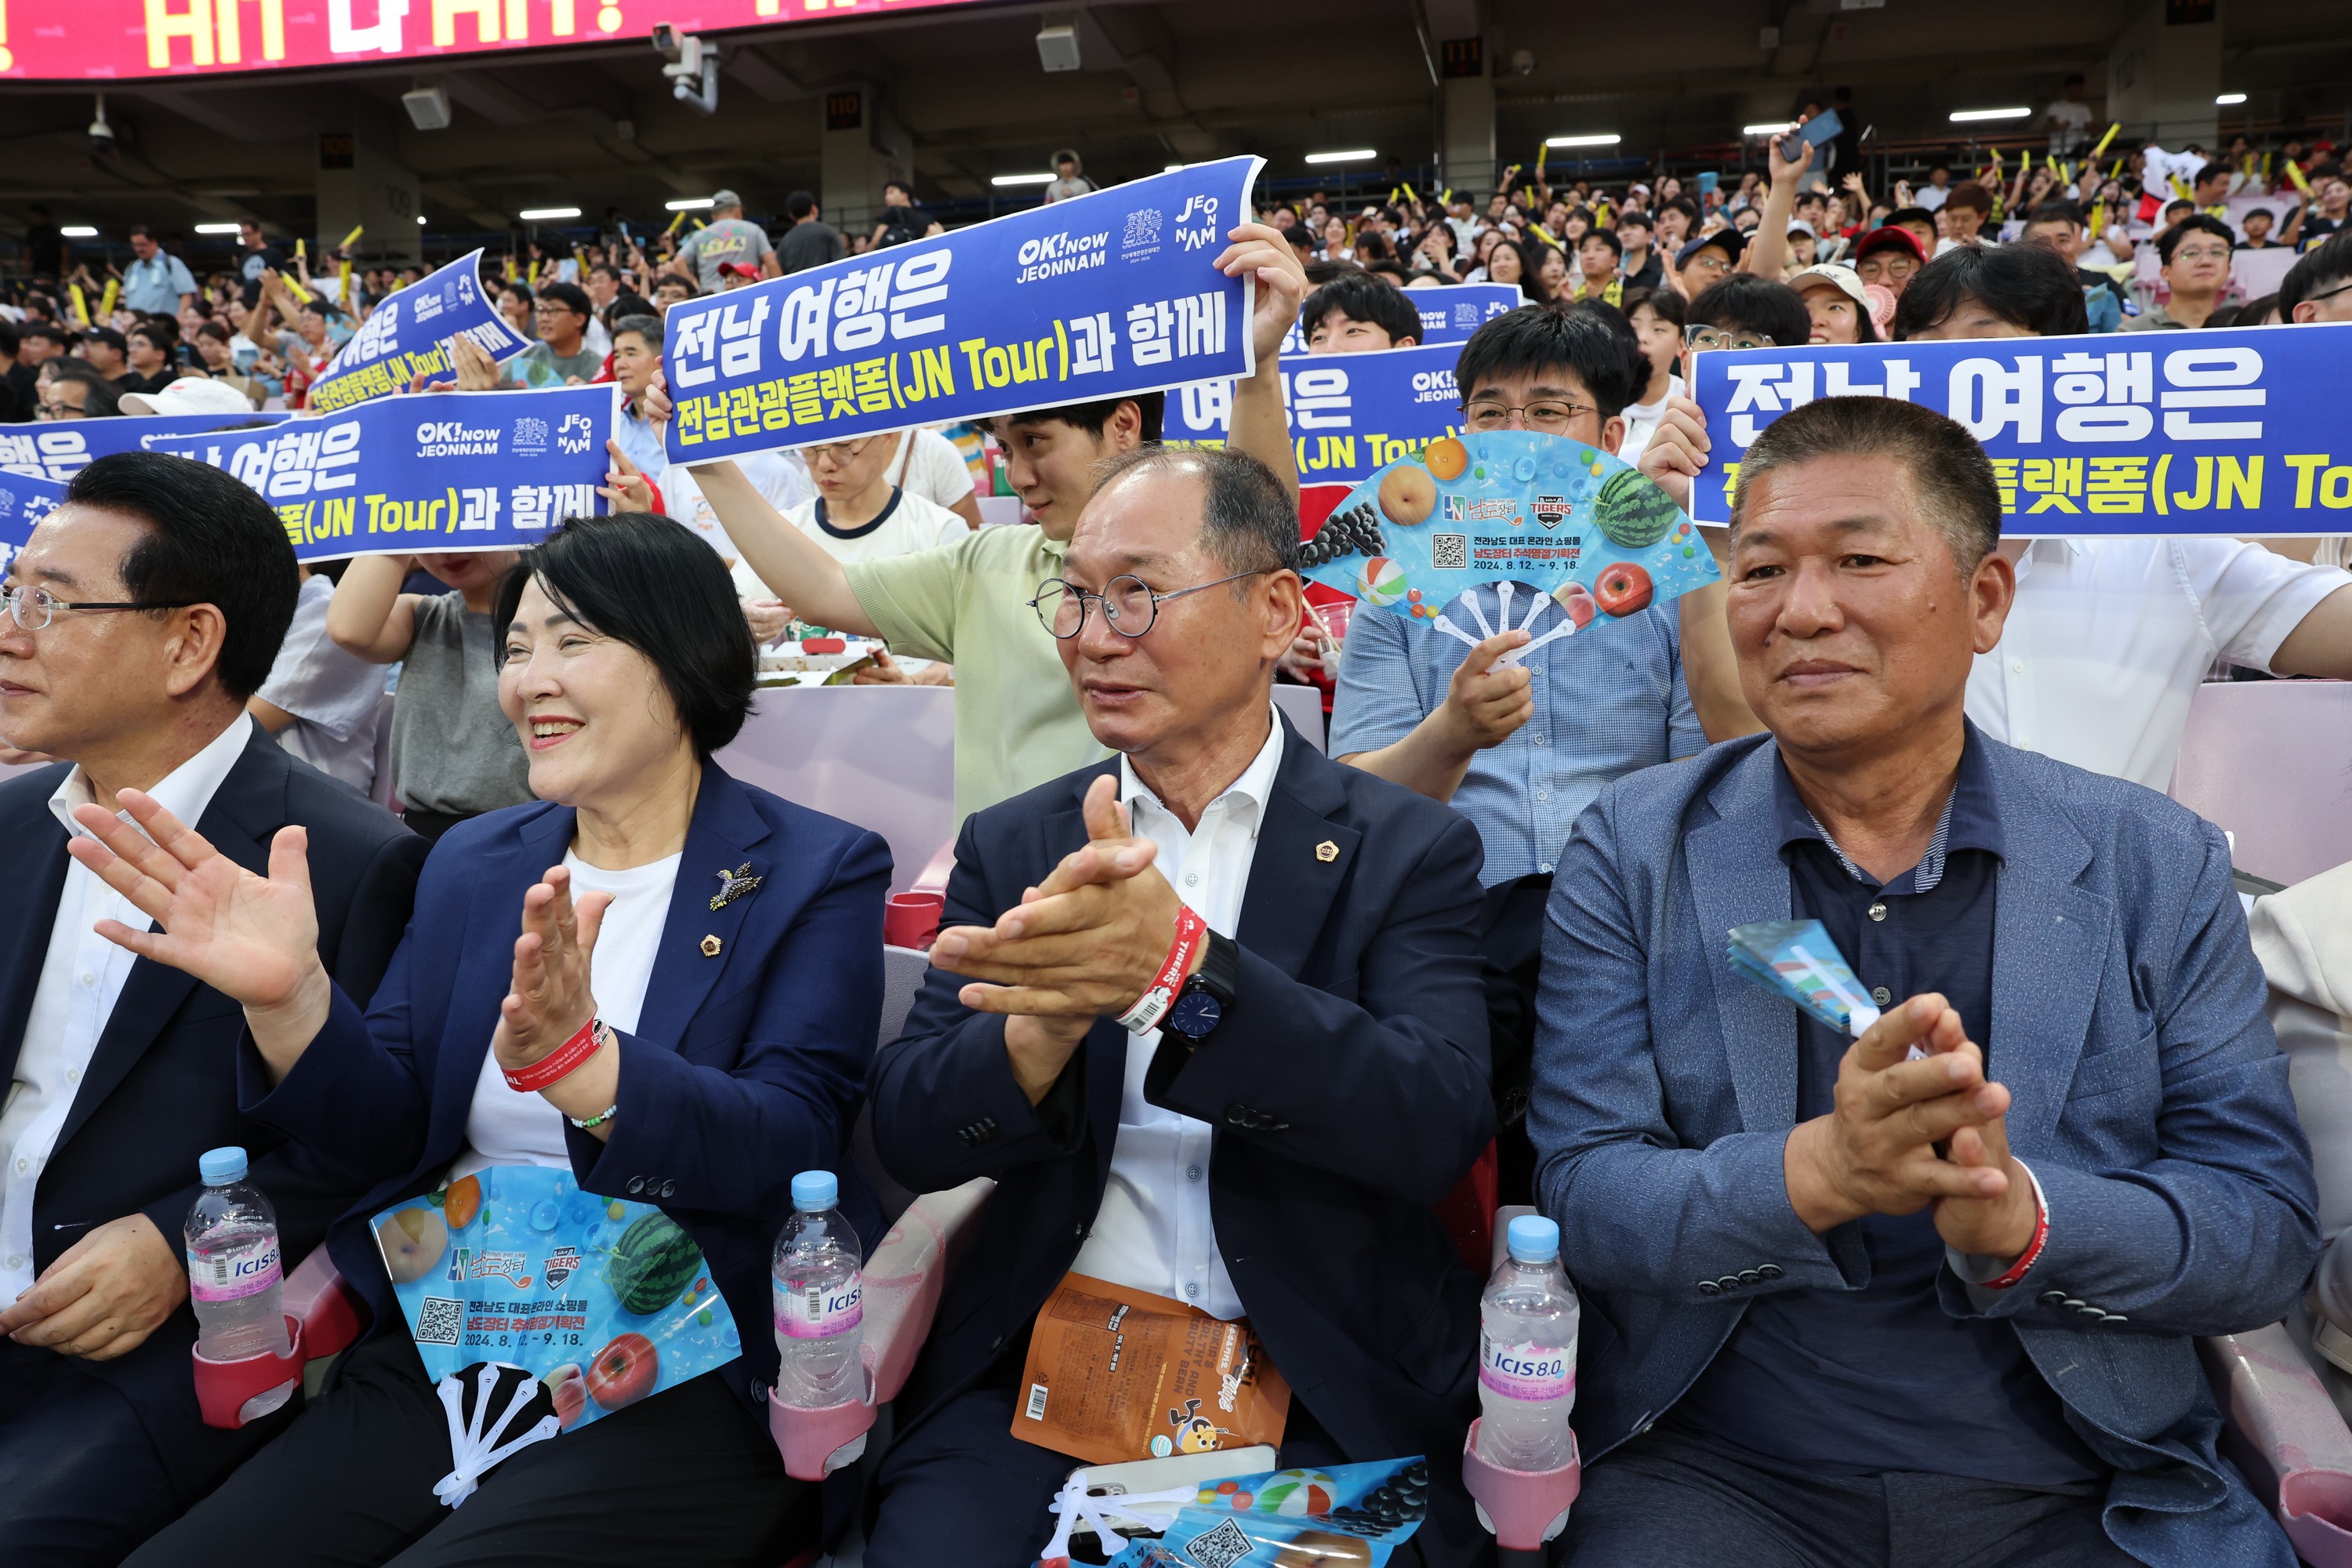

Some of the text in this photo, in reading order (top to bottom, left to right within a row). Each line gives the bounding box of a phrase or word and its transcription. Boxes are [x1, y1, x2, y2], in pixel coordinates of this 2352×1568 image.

[1017, 251, 1106, 284] JEONNAM
[673, 248, 953, 389] 전남 여행은
[677, 344, 953, 446] 전남관광플랫폼(JN
[960, 313, 1116, 393] Tour)과
[1127, 291, 1226, 368] 함께
[1948, 346, 2267, 445] 여행은
[416, 443, 499, 458] JEONNAM
[2284, 454, 2352, 509] To
[364, 487, 502, 534] Tour)과
[511, 483, 595, 530] 함께
[1530, 503, 1573, 515] TIGERS
[1474, 536, 1581, 546] 전라남도 대표 온라인 쇼핑몰
[1474, 549, 1581, 559] 남도장터 추석명절기획전
[1474, 561, 1503, 570] 2024.
[1507, 561, 1515, 570] 8.
[1519, 561, 1534, 570] 12.
[1549, 561, 1559, 570] 9.
[1564, 561, 1579, 570] 18.
[1162, 940, 1190, 987] TIGERS
[544, 1256, 582, 1272] TIGERS
[469, 1300, 588, 1315] 전라남도 대표 온라인 쇼핑몰
[466, 1316, 509, 1331] 남도장터
[464, 1334, 494, 1347] 2024.
[499, 1334, 512, 1348] 8.
[543, 1333, 556, 1345] 9.
[562, 1334, 583, 1346] 18.
[1173, 1359, 1189, 1395] BEAN
[1187, 1371, 1200, 1397] AND
